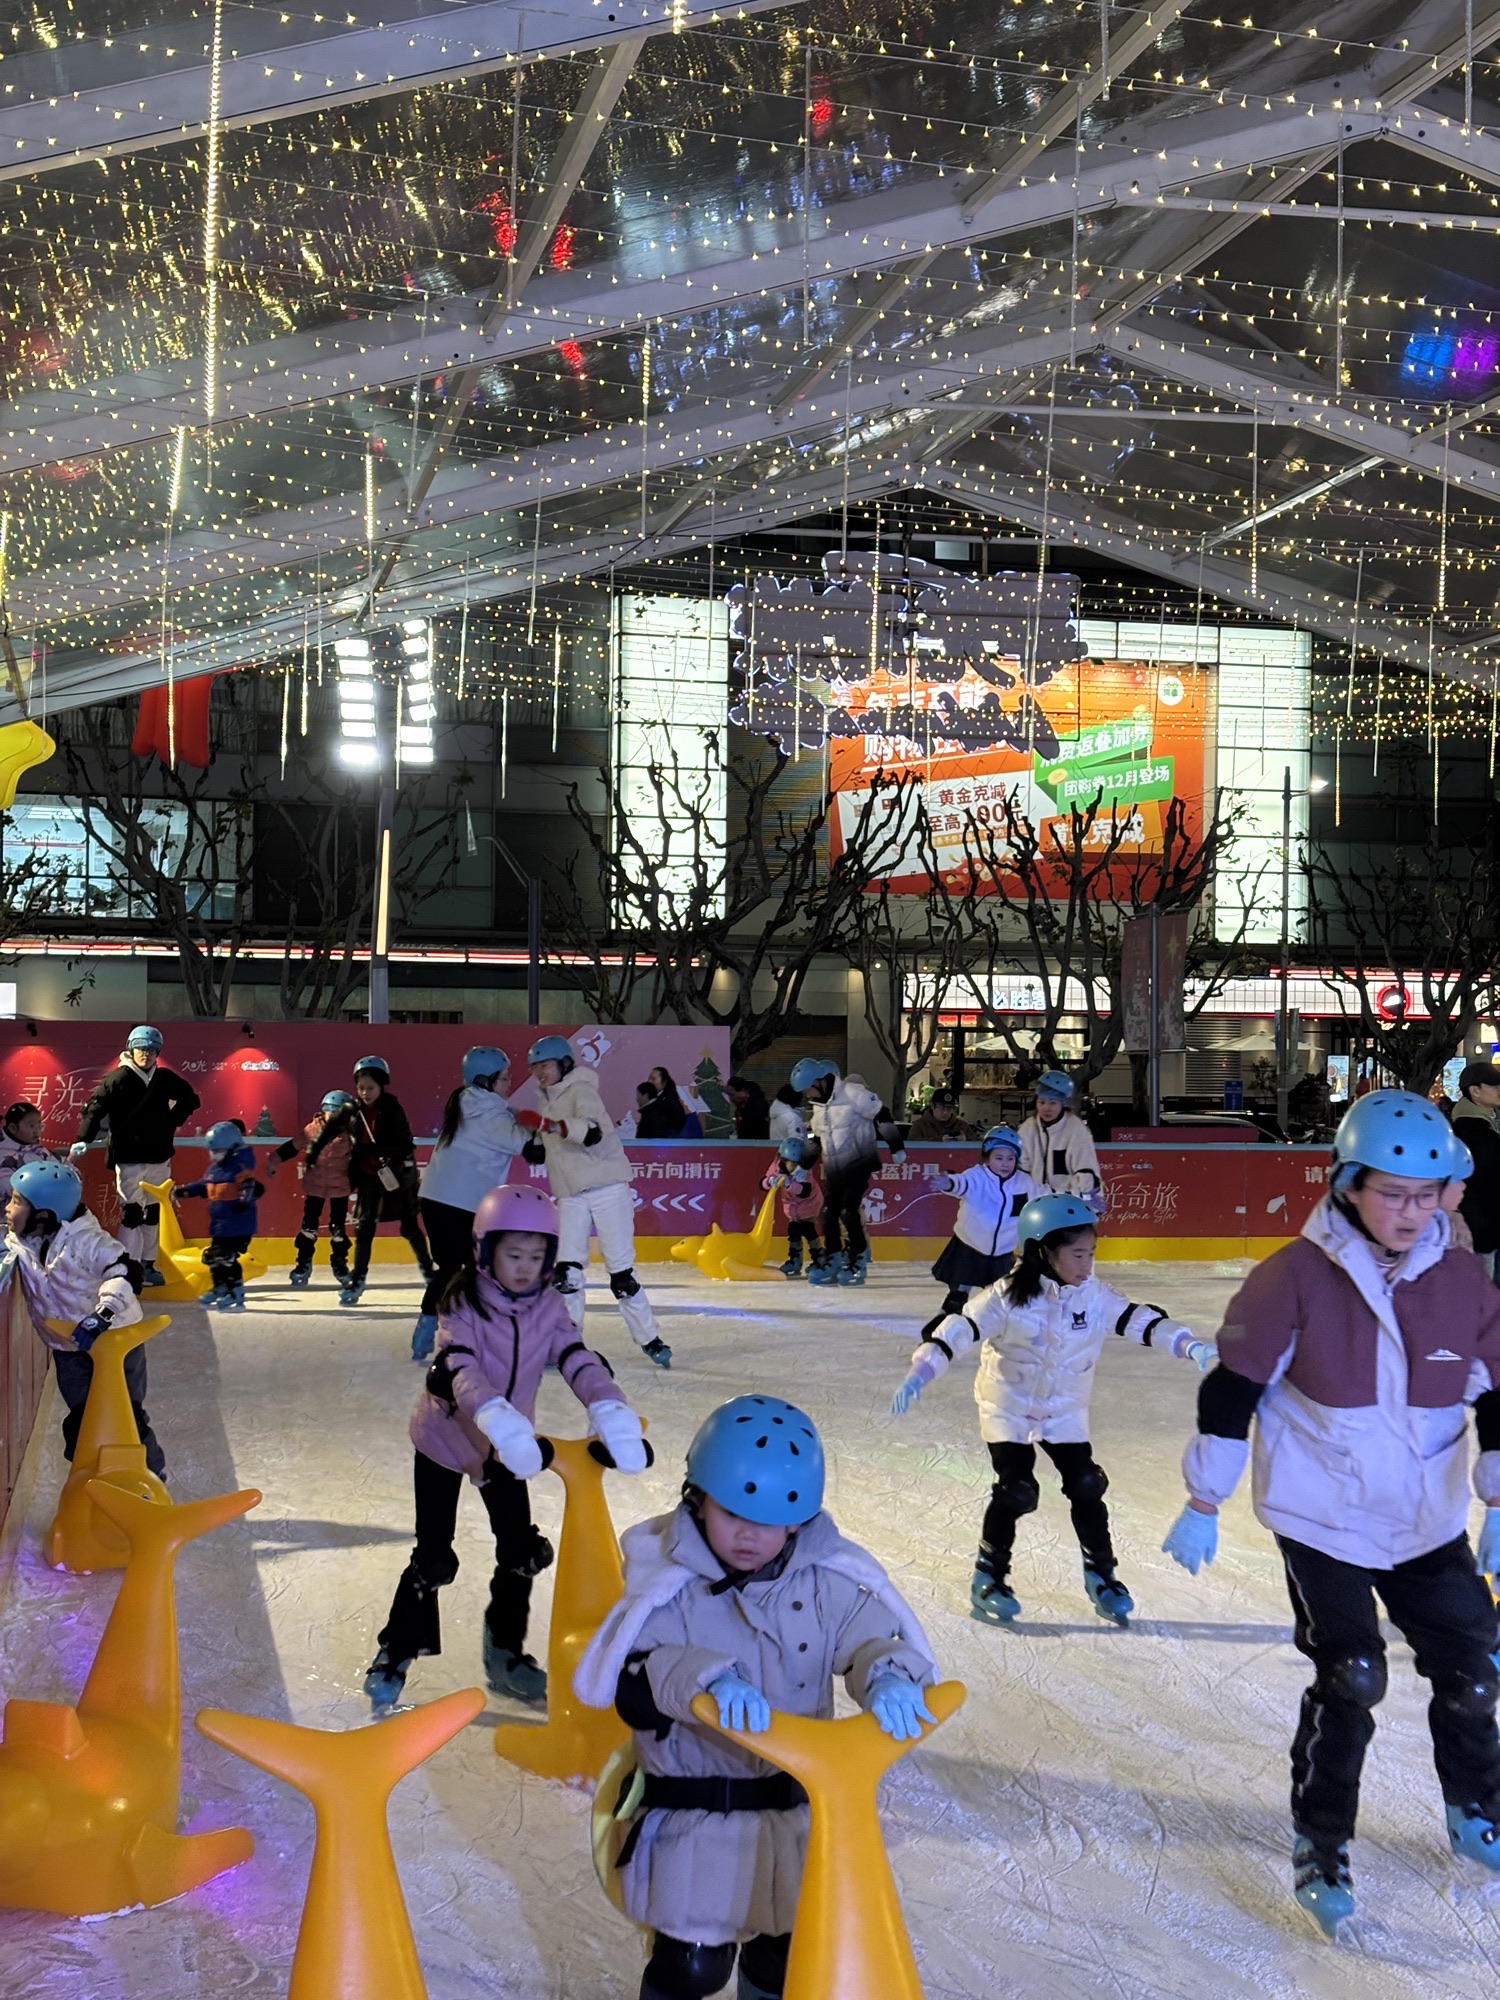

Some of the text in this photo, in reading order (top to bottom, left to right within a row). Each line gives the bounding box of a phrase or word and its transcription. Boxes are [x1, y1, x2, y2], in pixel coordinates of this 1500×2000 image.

[938, 781, 1007, 807] 黄金克减
[1063, 765, 1170, 798] 团购券12月登场
